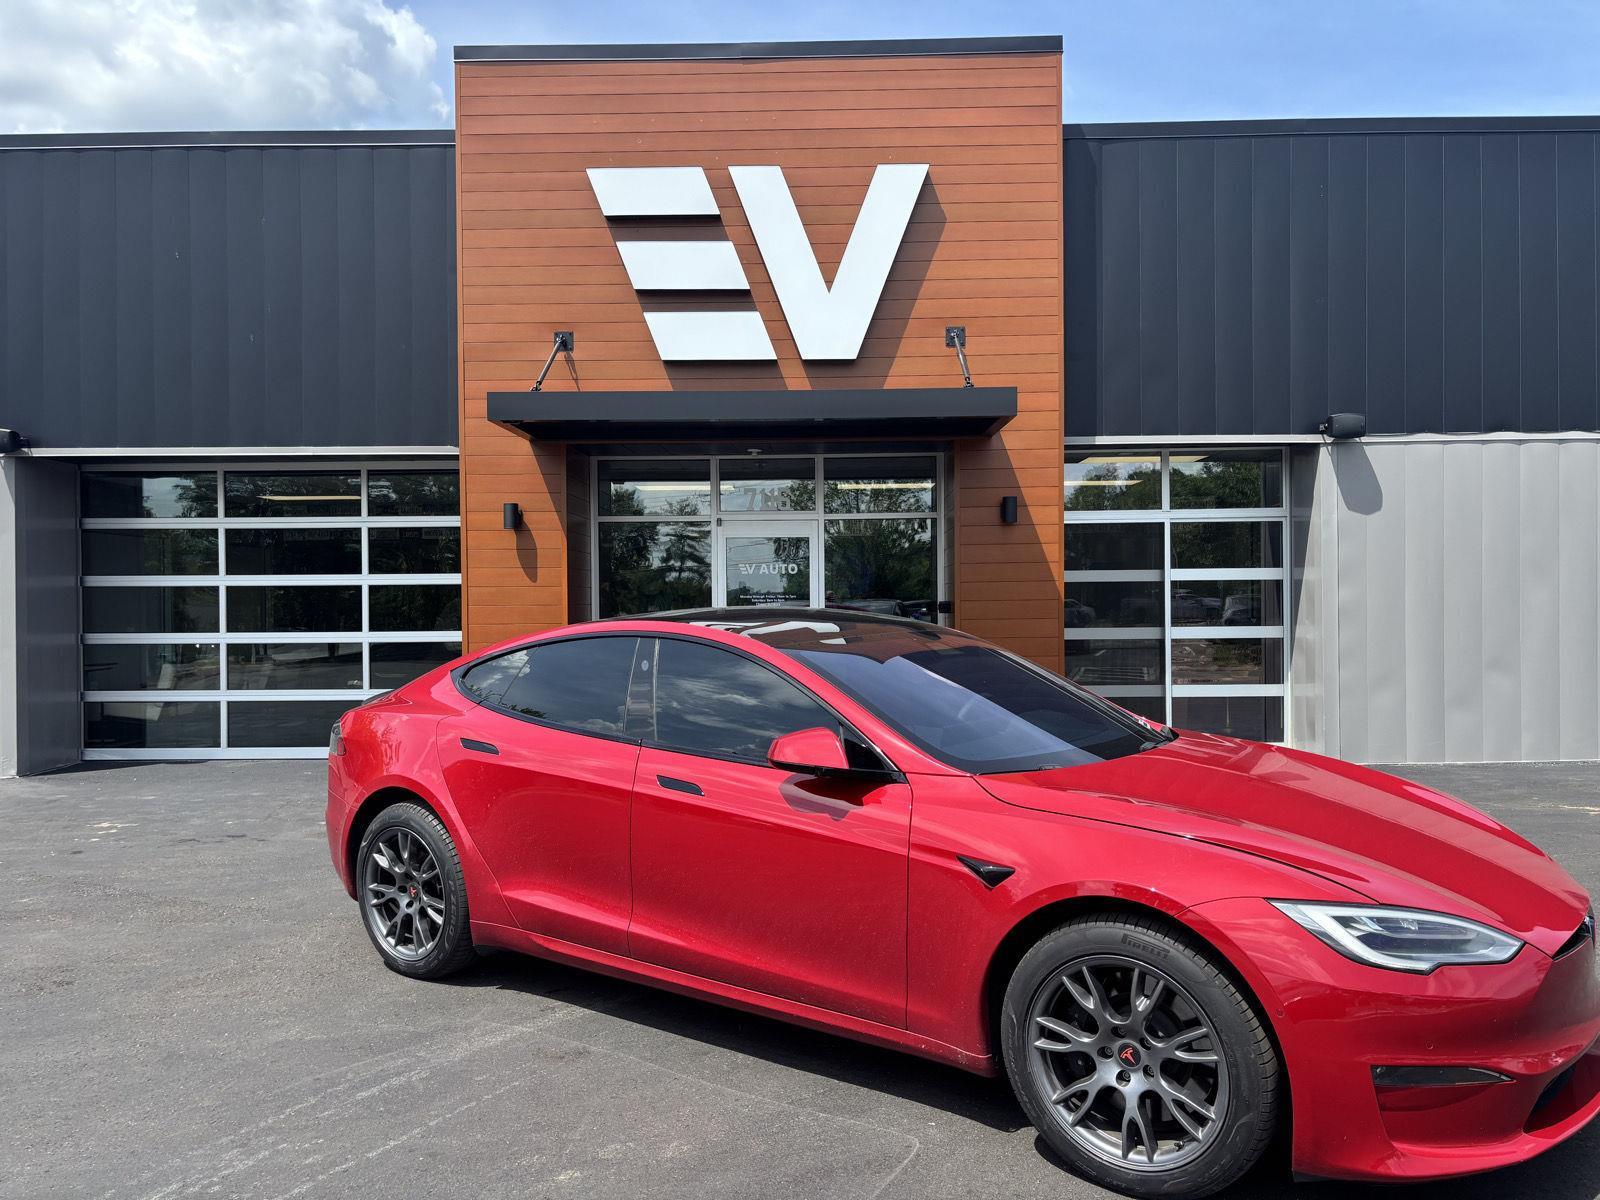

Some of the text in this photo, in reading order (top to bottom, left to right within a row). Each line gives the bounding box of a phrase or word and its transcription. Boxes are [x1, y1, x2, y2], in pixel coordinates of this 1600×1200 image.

[586, 163, 930, 361] EV
[739, 564, 798, 575] EV AUTO
[1121, 933, 1170, 960] PIRELLI
